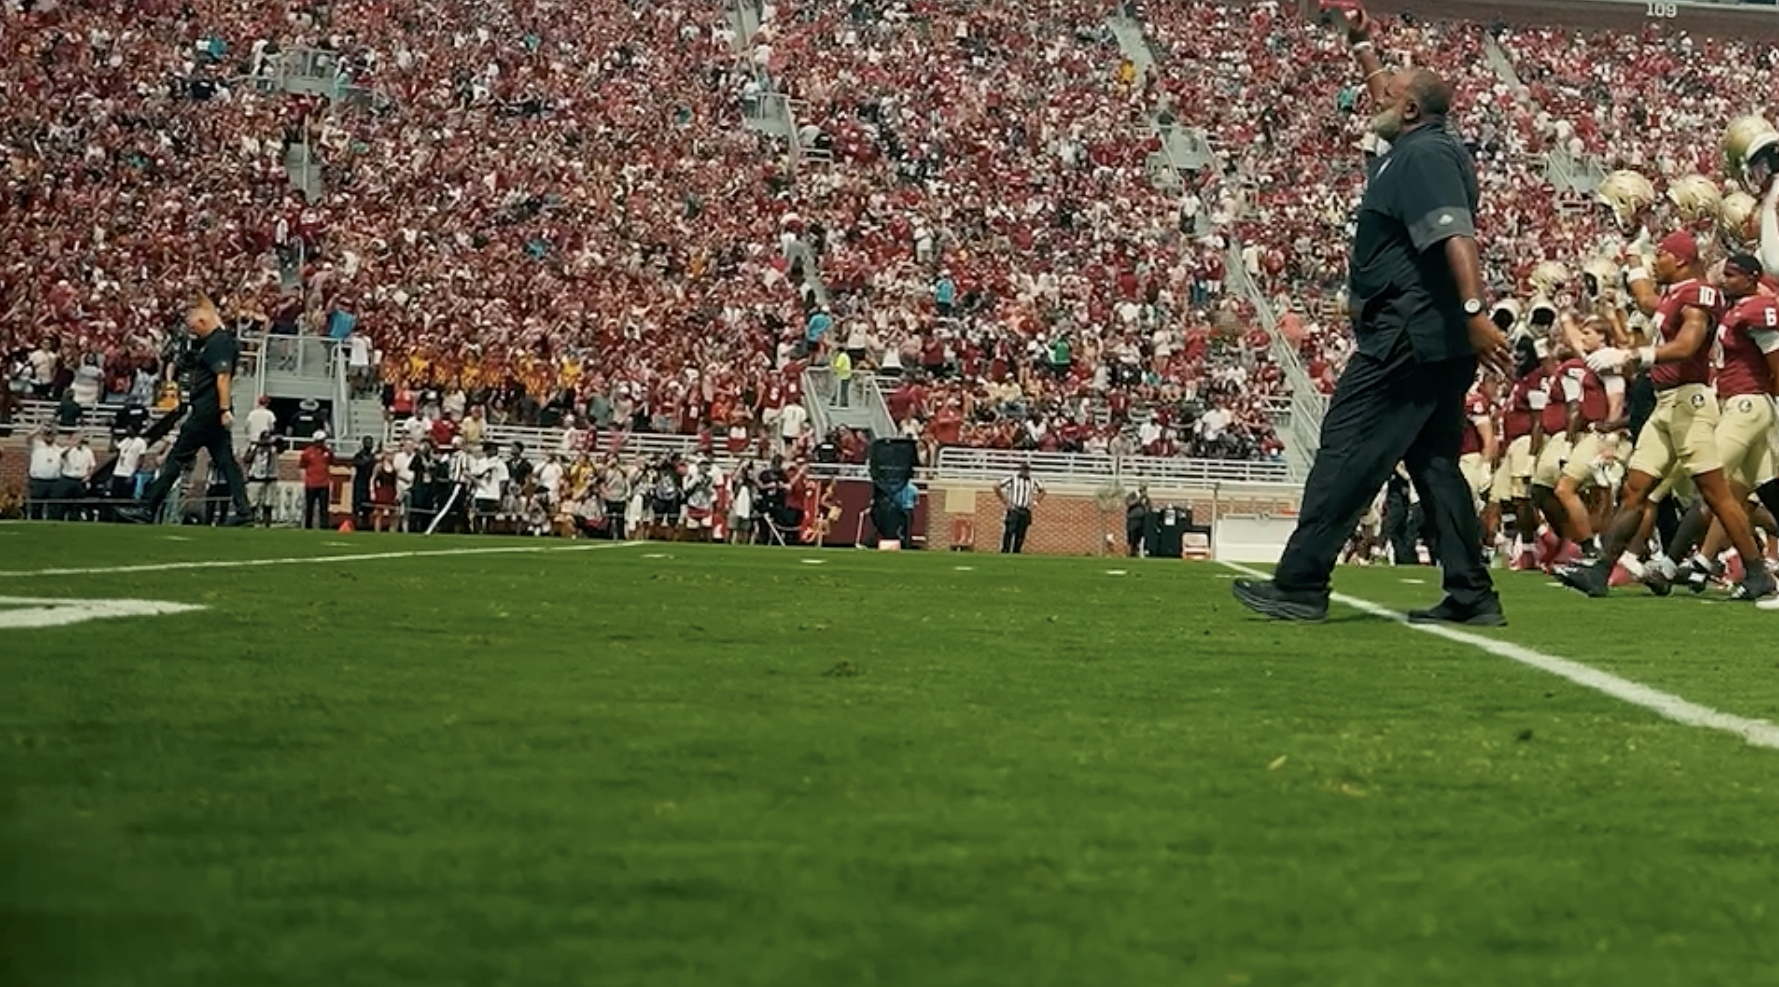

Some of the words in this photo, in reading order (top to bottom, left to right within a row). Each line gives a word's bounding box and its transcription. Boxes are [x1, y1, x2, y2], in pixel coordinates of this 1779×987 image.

[1645, 2, 1678, 18] 109
[1698, 285, 1716, 307] 10
[1764, 307, 1778, 327] 6
